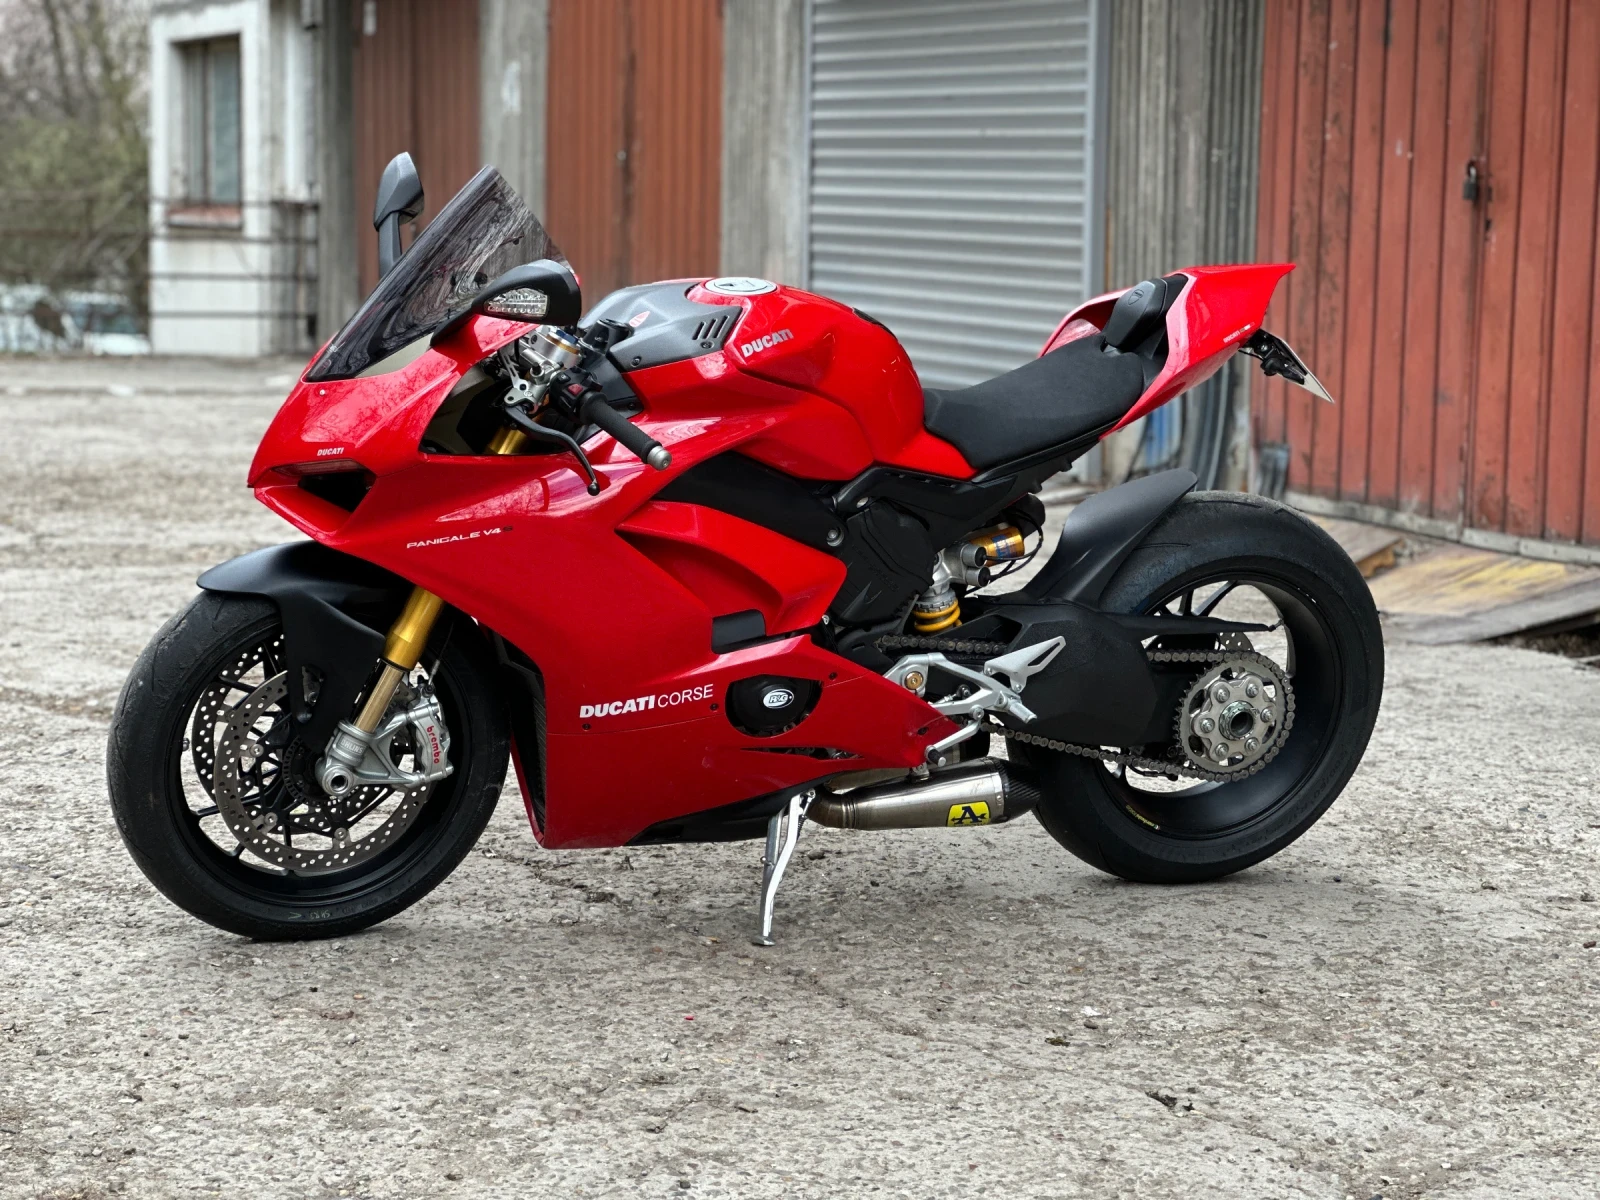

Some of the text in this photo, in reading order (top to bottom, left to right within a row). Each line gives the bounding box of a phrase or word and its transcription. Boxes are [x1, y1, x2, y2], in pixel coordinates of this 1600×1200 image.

[740, 328, 794, 358] DUCATI
[316, 447, 345, 457] DUCATI
[406, 531, 481, 549] PANIGALE
[579, 684, 714, 718] DUCATI CORSE
[426, 725, 442, 764] brembo
